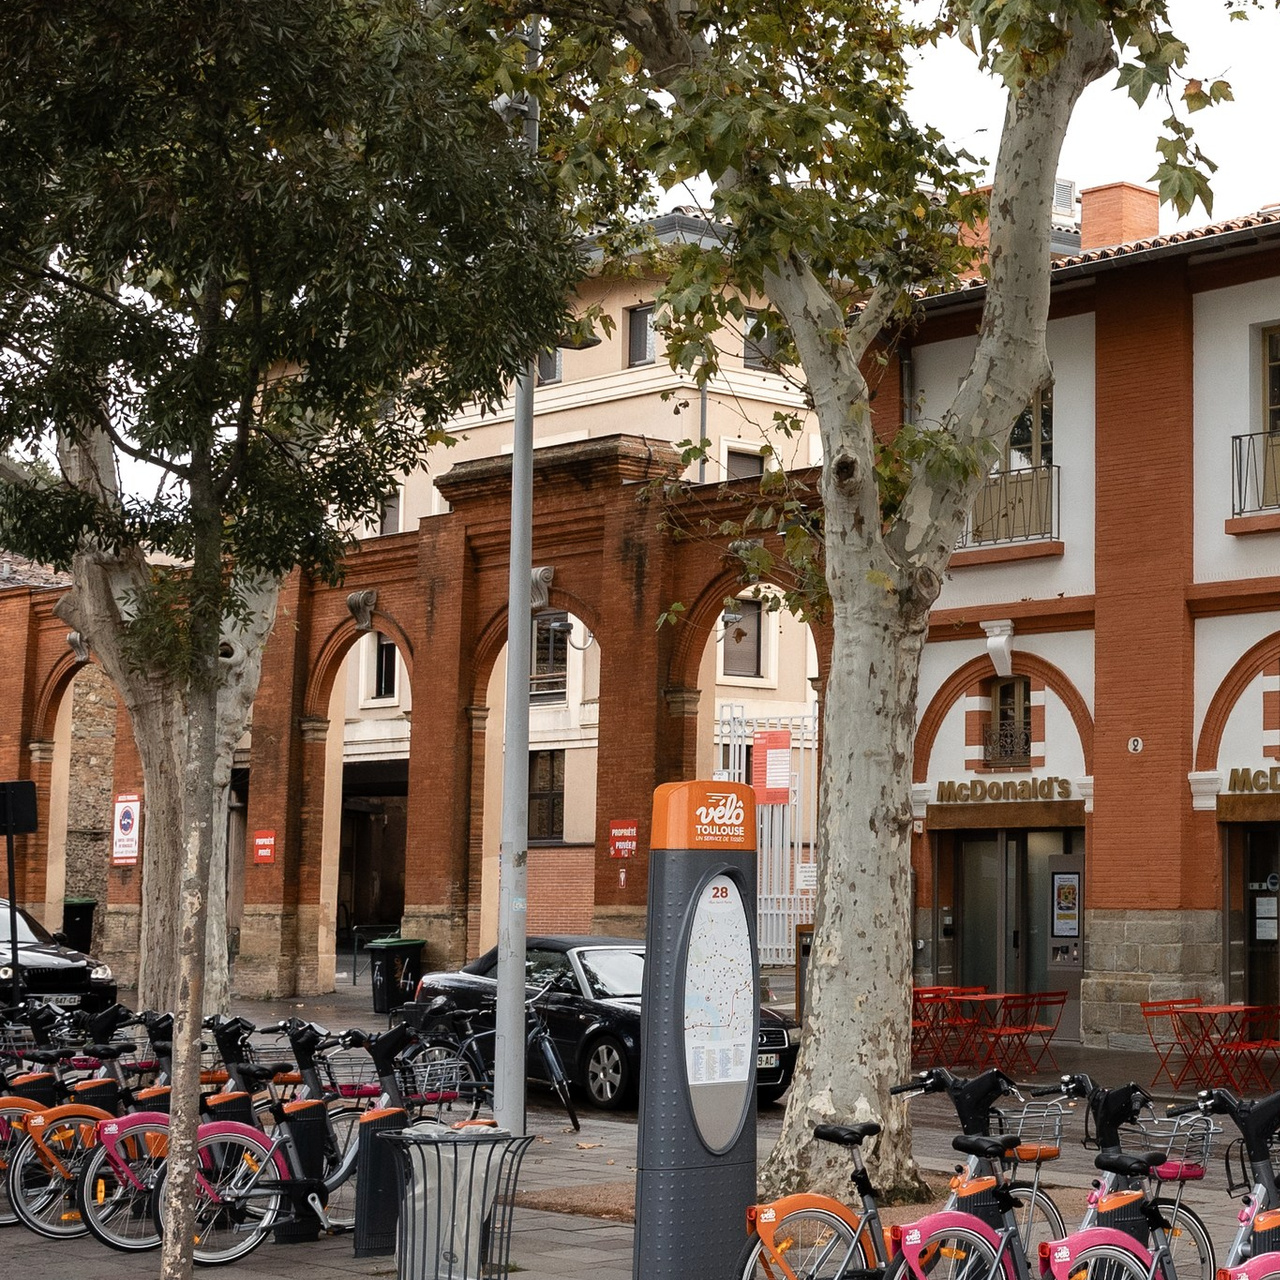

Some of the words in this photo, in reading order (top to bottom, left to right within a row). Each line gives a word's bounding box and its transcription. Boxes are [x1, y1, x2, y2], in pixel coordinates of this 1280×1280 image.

[1132, 738, 1139, 751] 2
[936, 776, 1073, 803] McDonald's
[695, 793, 745, 825] vélô
[695, 825, 745, 836] TOULOUSE
[712, 886, 728, 899] 28
